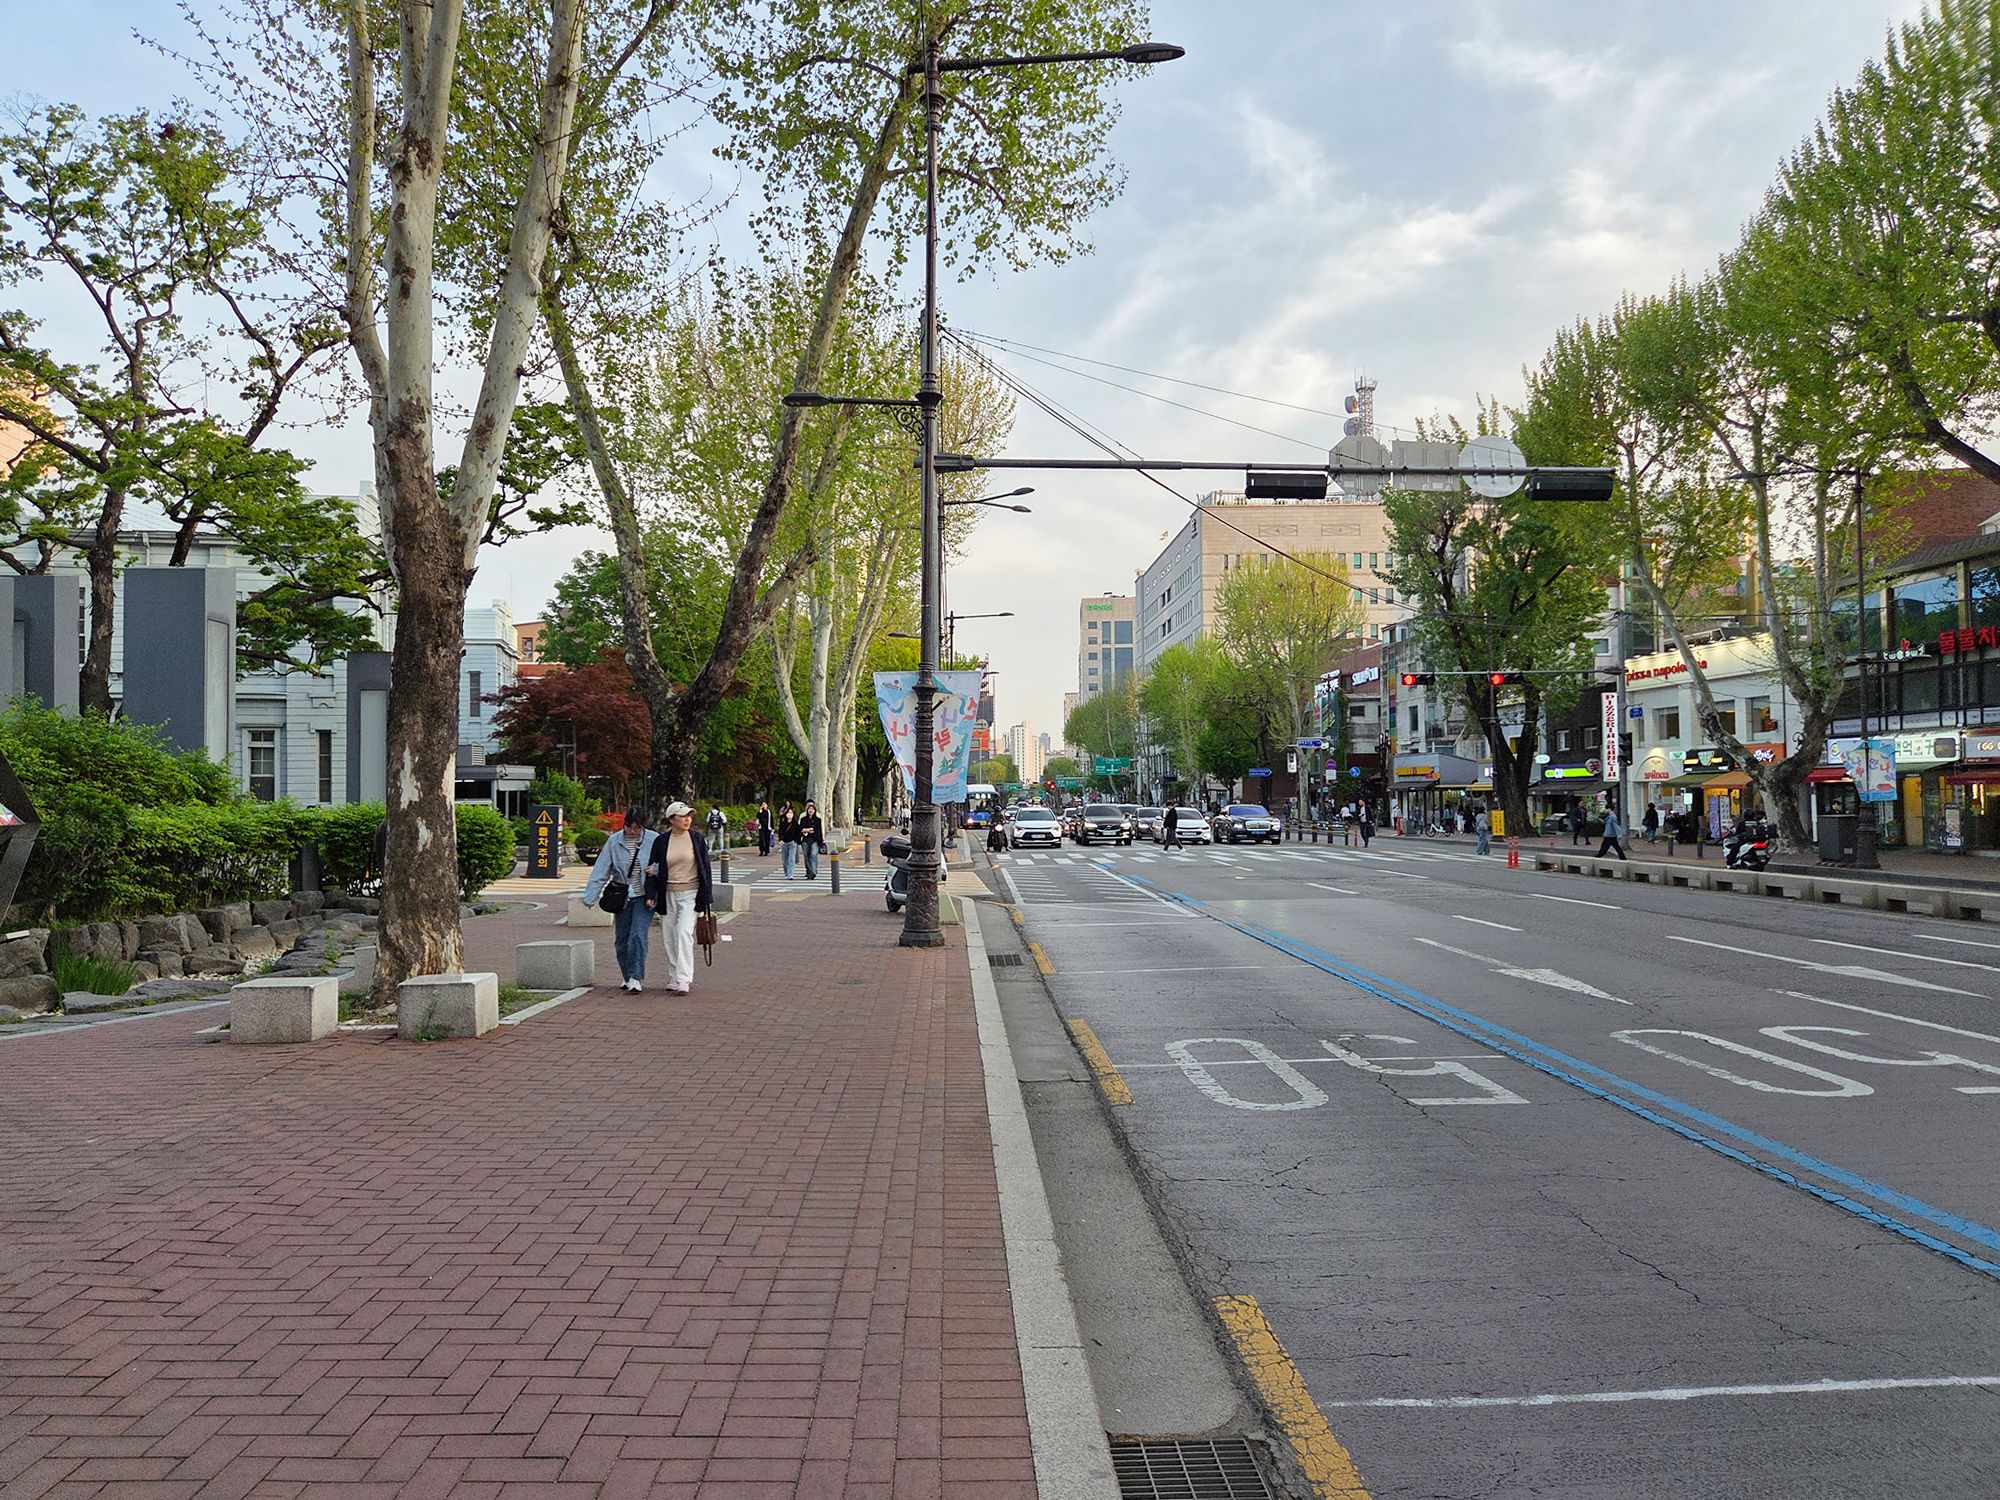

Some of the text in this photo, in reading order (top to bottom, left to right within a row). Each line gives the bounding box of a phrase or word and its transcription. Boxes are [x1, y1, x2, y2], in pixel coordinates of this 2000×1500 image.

[1939, 626, 2000, 655] 둘둘치
[1653, 659, 1707, 680] napolea
[1605, 694, 1615, 739] PIZZERIA
[1977, 742, 1995, 751] EGG
[537, 826, 549, 868] 출차주의
